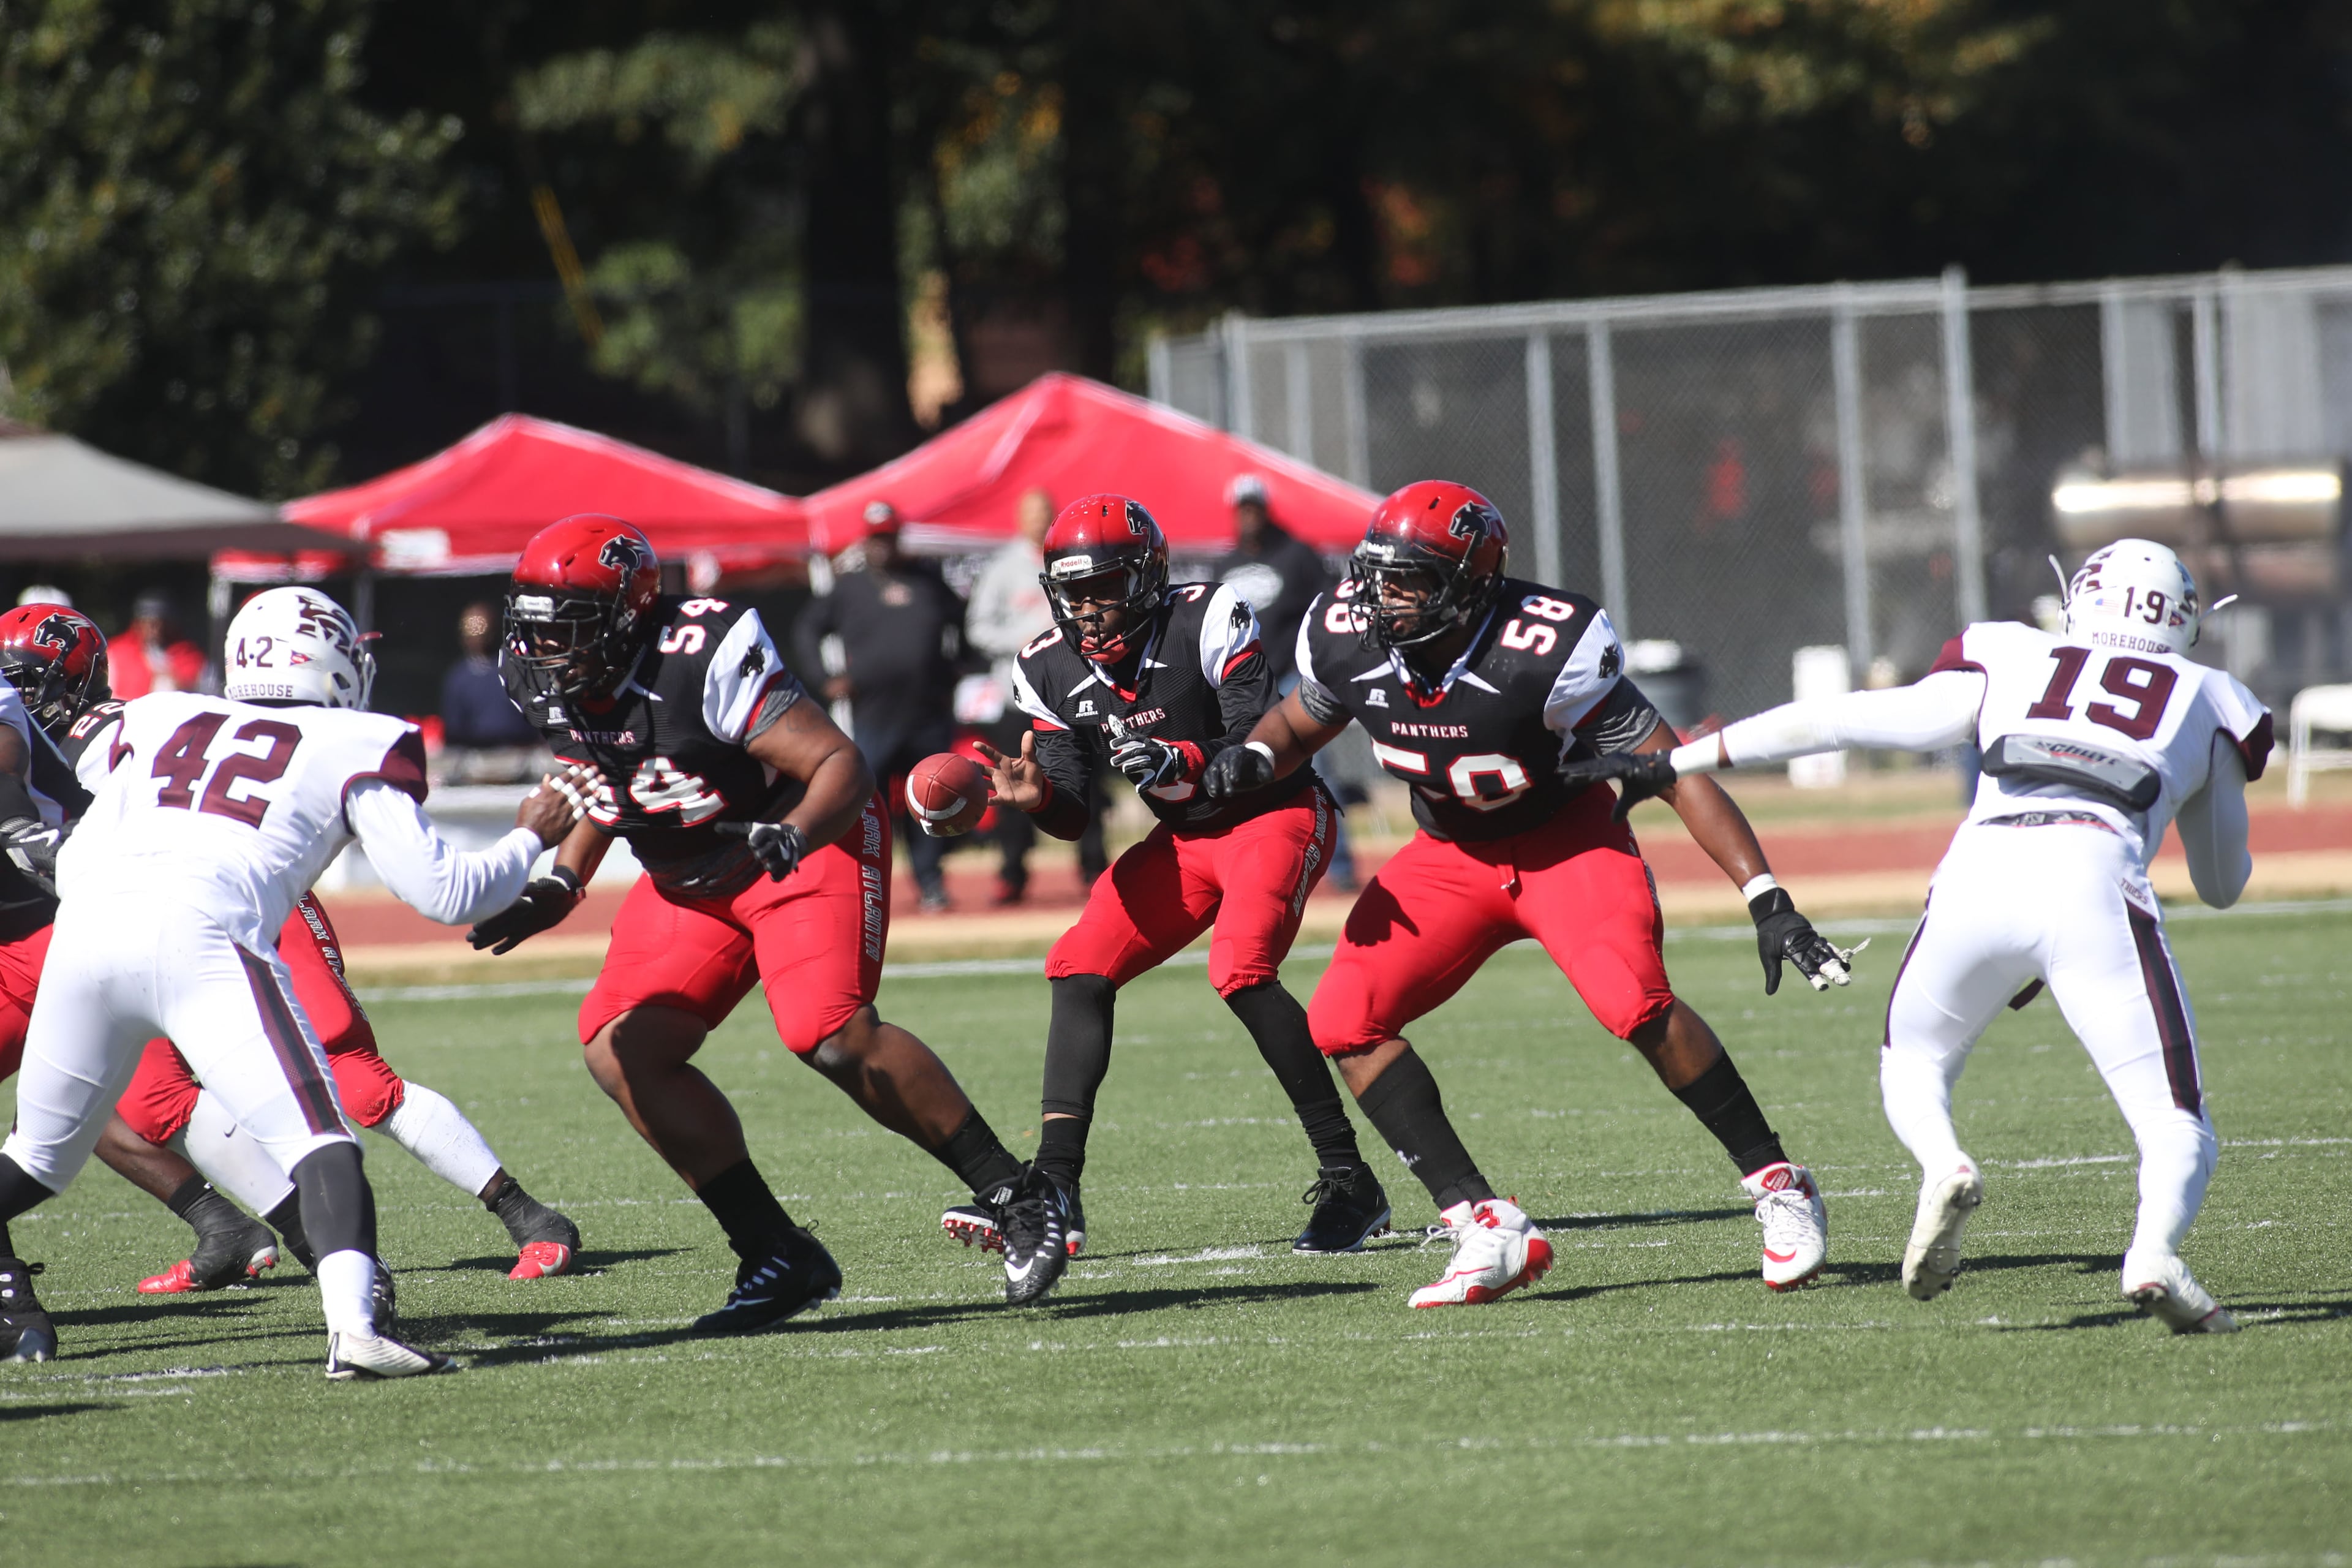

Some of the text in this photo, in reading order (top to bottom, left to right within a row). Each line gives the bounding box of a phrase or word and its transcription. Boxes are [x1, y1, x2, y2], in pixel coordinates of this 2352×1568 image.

[1060, 559, 1082, 568] Riddell
[657, 598, 730, 655] 54
[1500, 595, 1577, 657] 58
[228, 684, 293, 699] MOREHOUSE
[2026, 645, 2179, 742] 19
[69, 702, 124, 740] 22
[568, 728, 636, 745] PANTHERS
[1100, 707, 1166, 734] PTHERS
[1390, 721, 1469, 739] PANTHERS
[151, 712, 303, 829] 42
[861, 798, 883, 962] LARK ATLANTA
[298, 894, 330, 941] LARK
